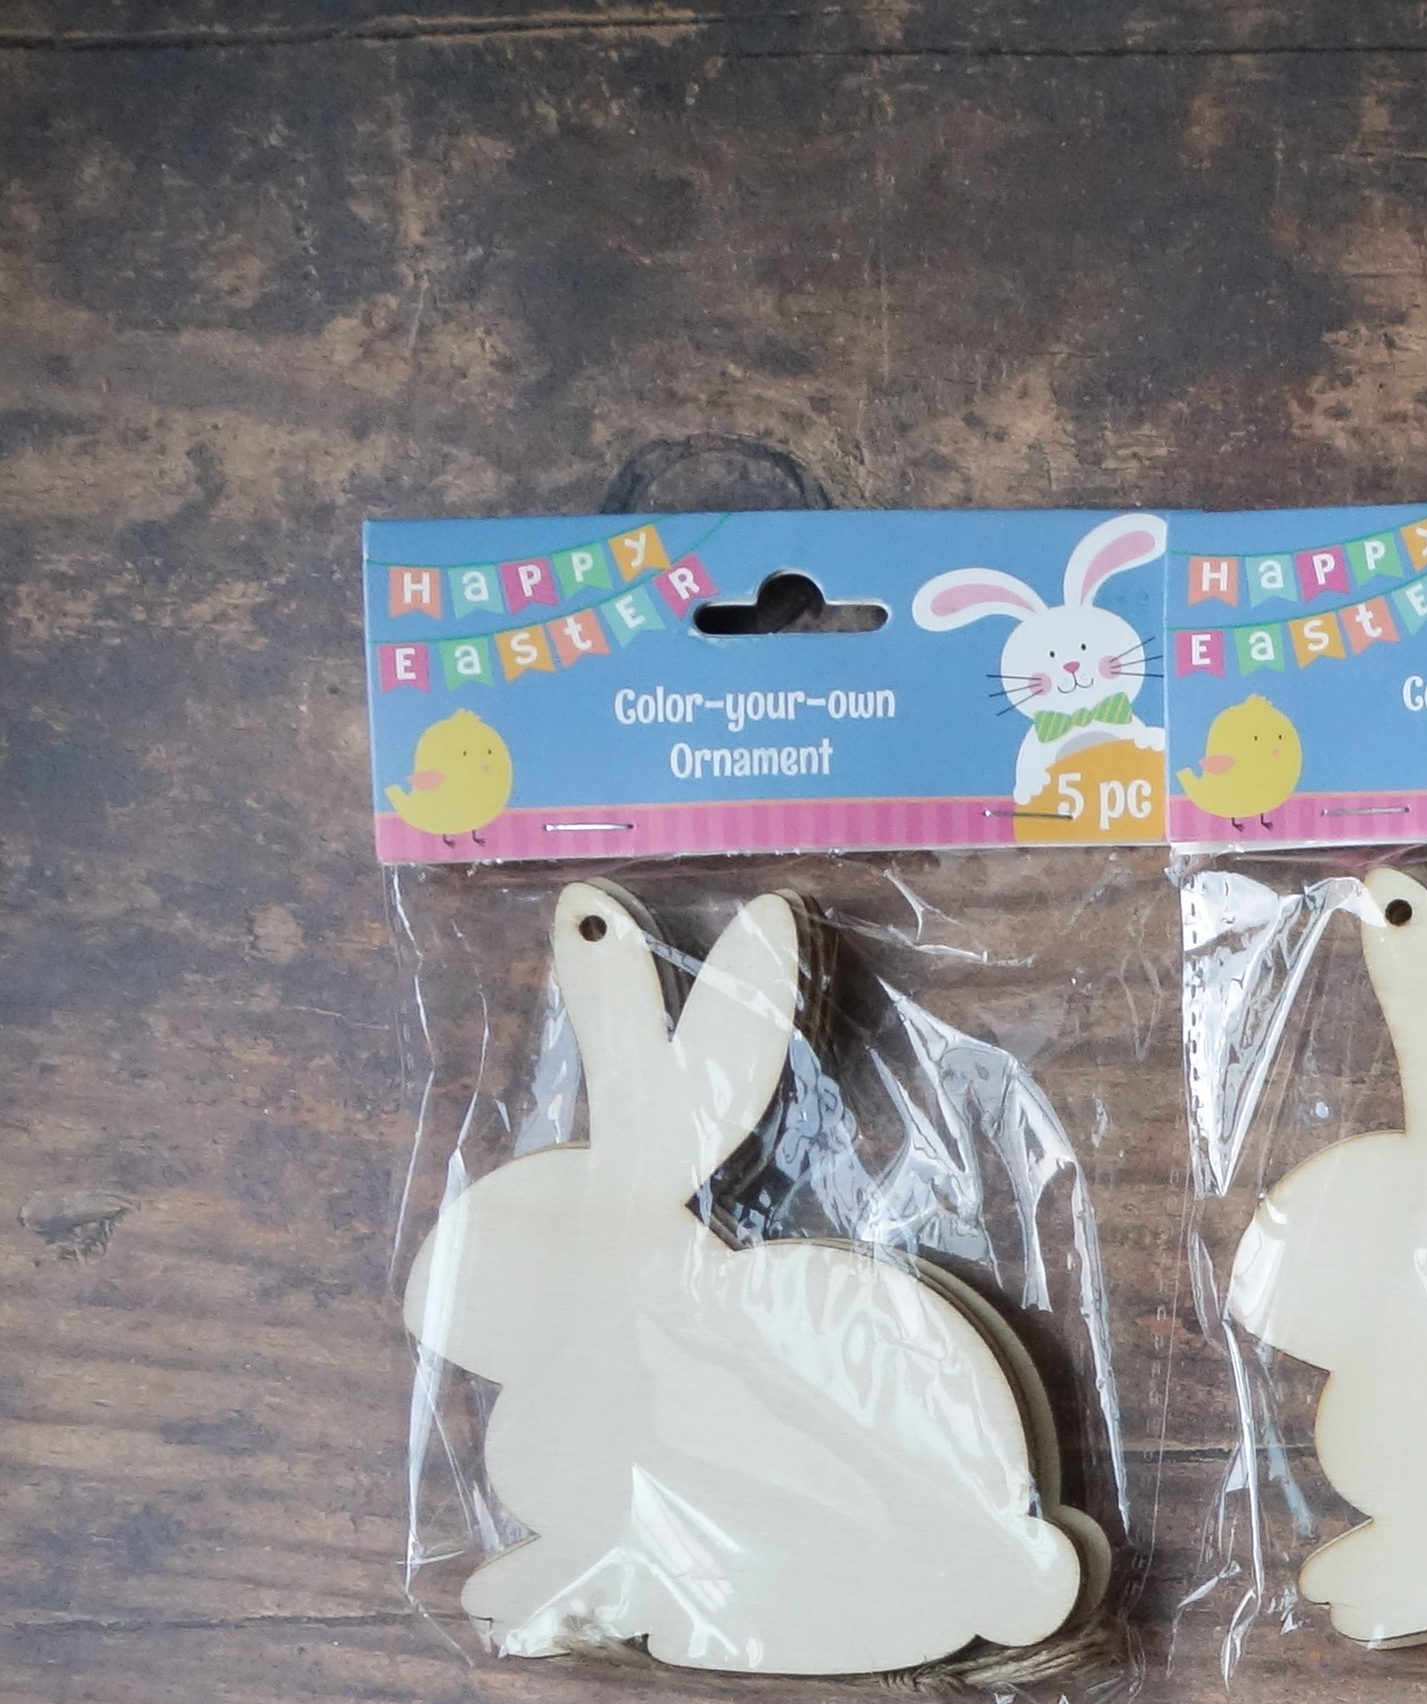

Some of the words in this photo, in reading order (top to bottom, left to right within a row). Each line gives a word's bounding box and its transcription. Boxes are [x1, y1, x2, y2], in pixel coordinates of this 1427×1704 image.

[614, 685, 896, 729] Color-your-own
[670, 737, 834, 779] Ornament
[1055, 772, 1084, 821] 5
[1100, 777, 1153, 831] pc
